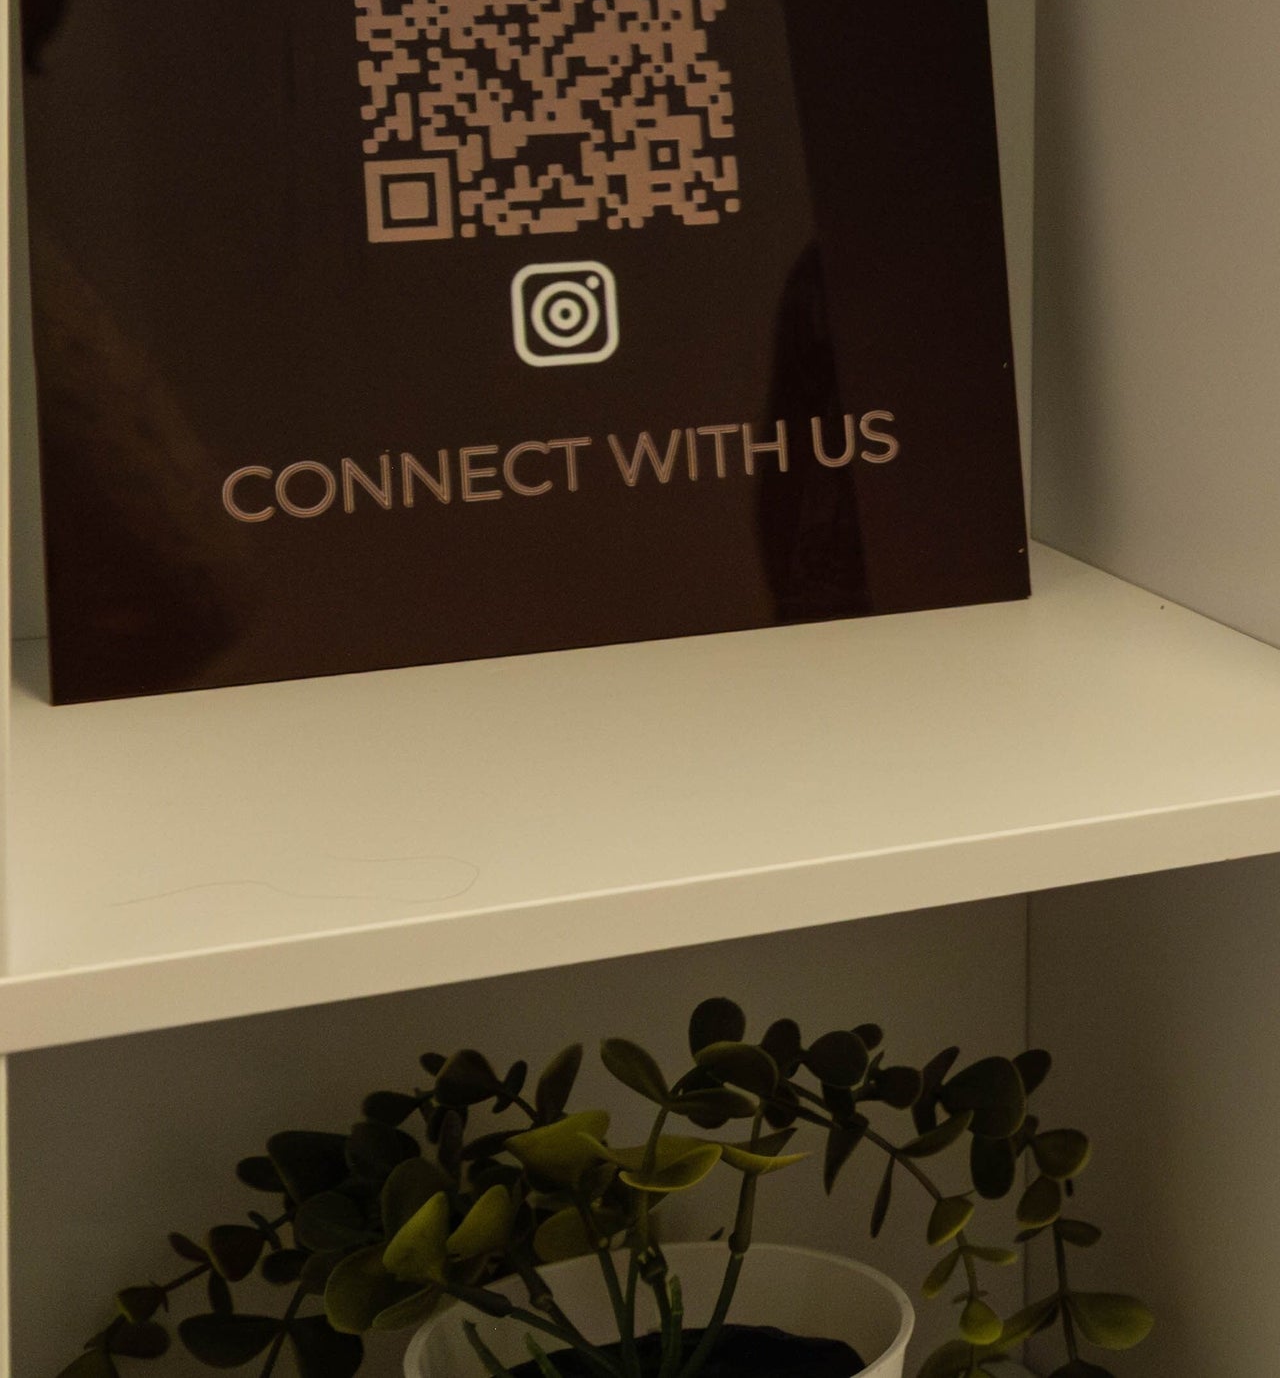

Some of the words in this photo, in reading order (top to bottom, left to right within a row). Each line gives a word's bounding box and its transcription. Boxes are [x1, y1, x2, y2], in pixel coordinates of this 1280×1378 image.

[222, 437, 592, 522] CONNECT
[607, 420, 788, 486] WITH
[811, 409, 899, 468] US
